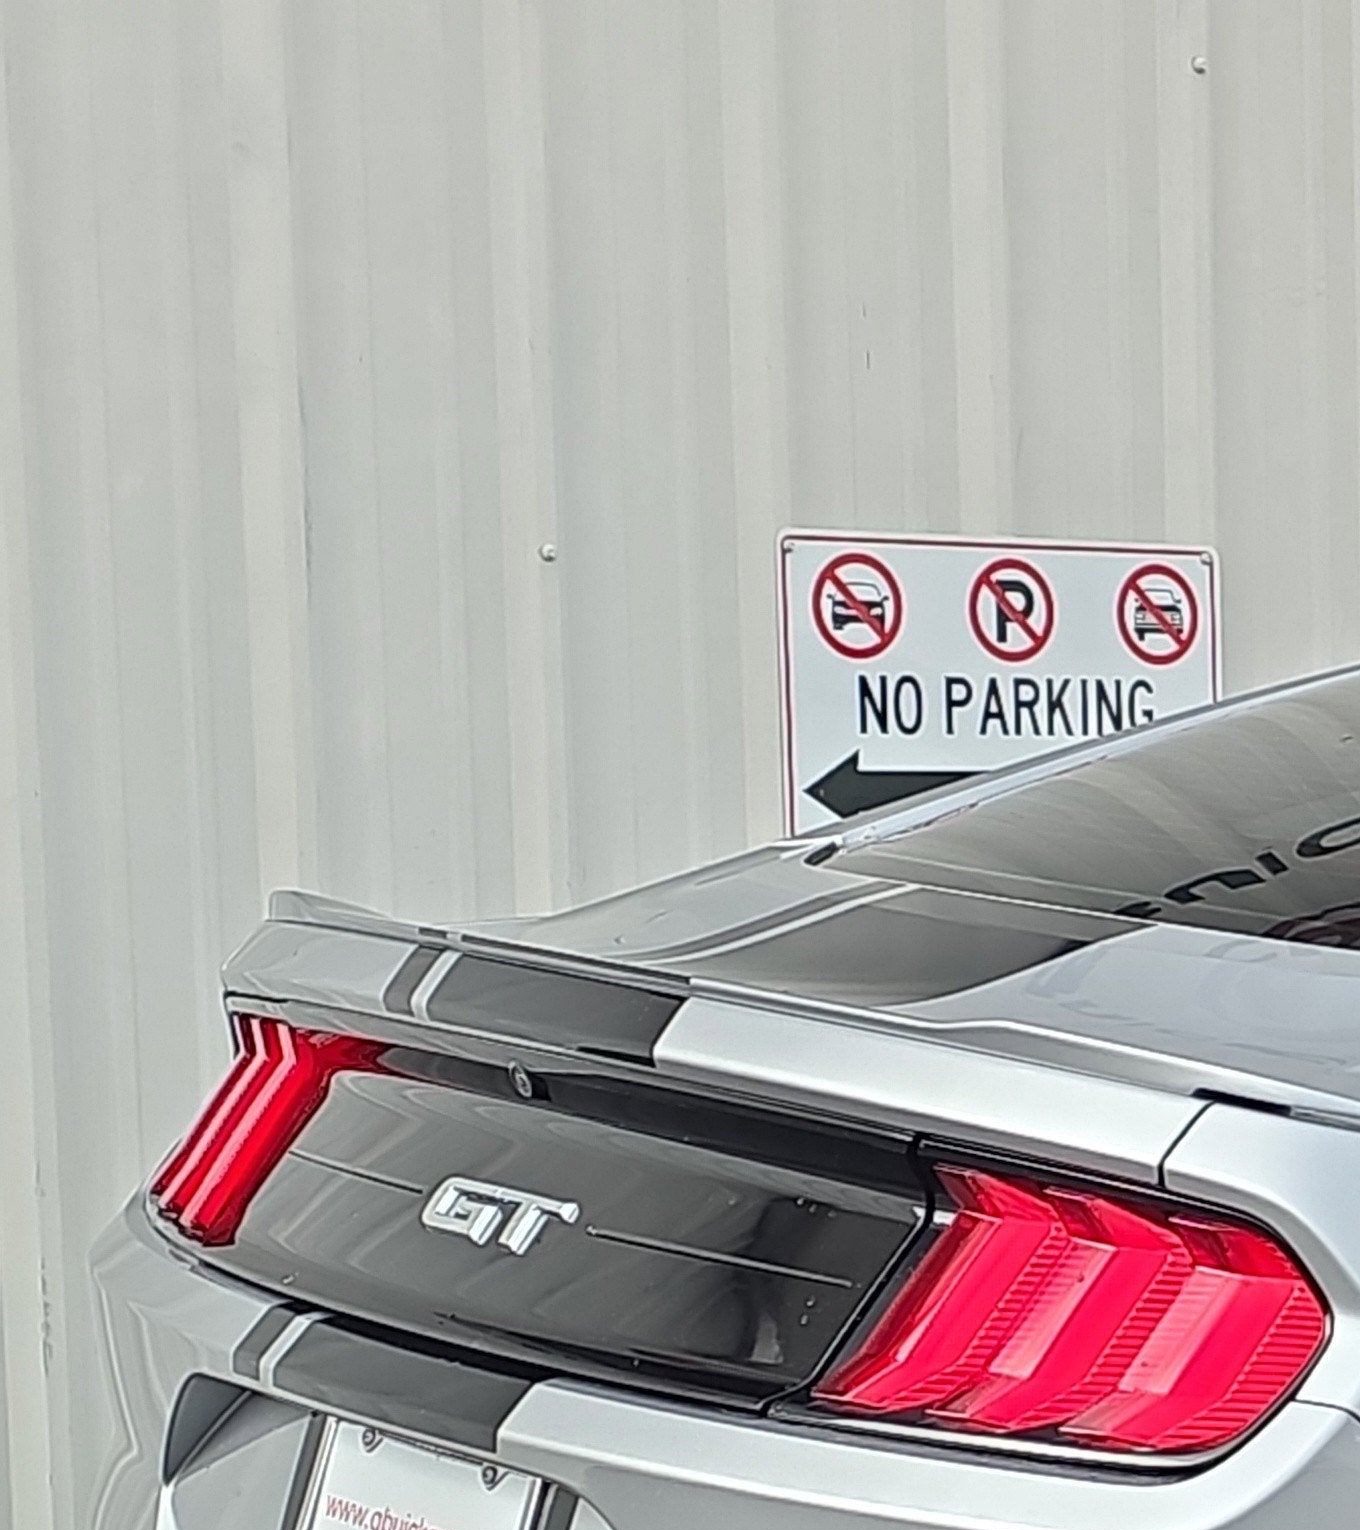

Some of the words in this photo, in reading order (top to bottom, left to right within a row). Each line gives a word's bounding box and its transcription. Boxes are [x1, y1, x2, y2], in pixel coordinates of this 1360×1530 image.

[858, 675, 922, 735] NO
[943, 676, 1155, 737] PARKING
[420, 1176, 580, 1255] GT
